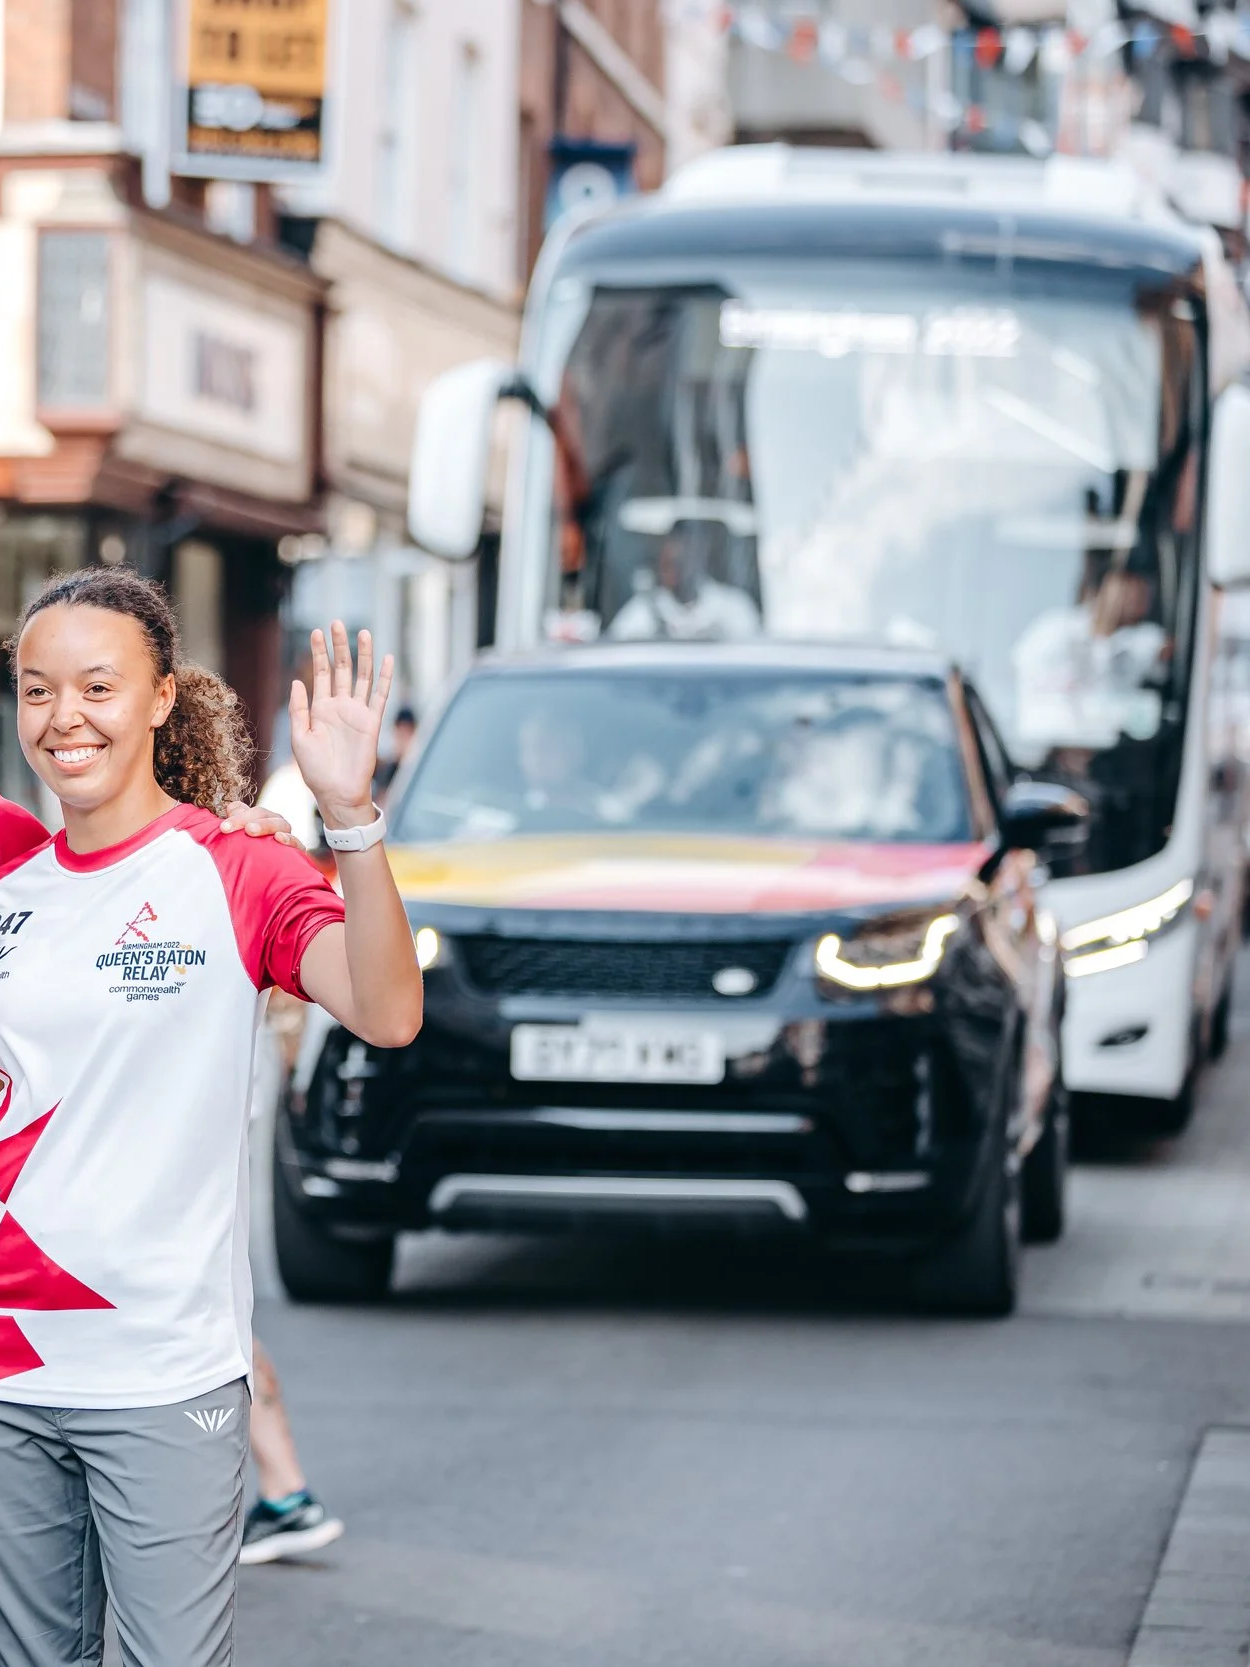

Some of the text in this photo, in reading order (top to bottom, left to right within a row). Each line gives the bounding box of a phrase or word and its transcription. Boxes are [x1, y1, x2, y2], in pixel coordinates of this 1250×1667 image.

[121, 941, 180, 951] BIRMINGHAM 2022
[96, 950, 206, 970] QUEEN'S BATON
[122, 966, 170, 981] RELAY
[108, 985, 181, 994] commonwealth
[126, 993, 160, 1002] games
